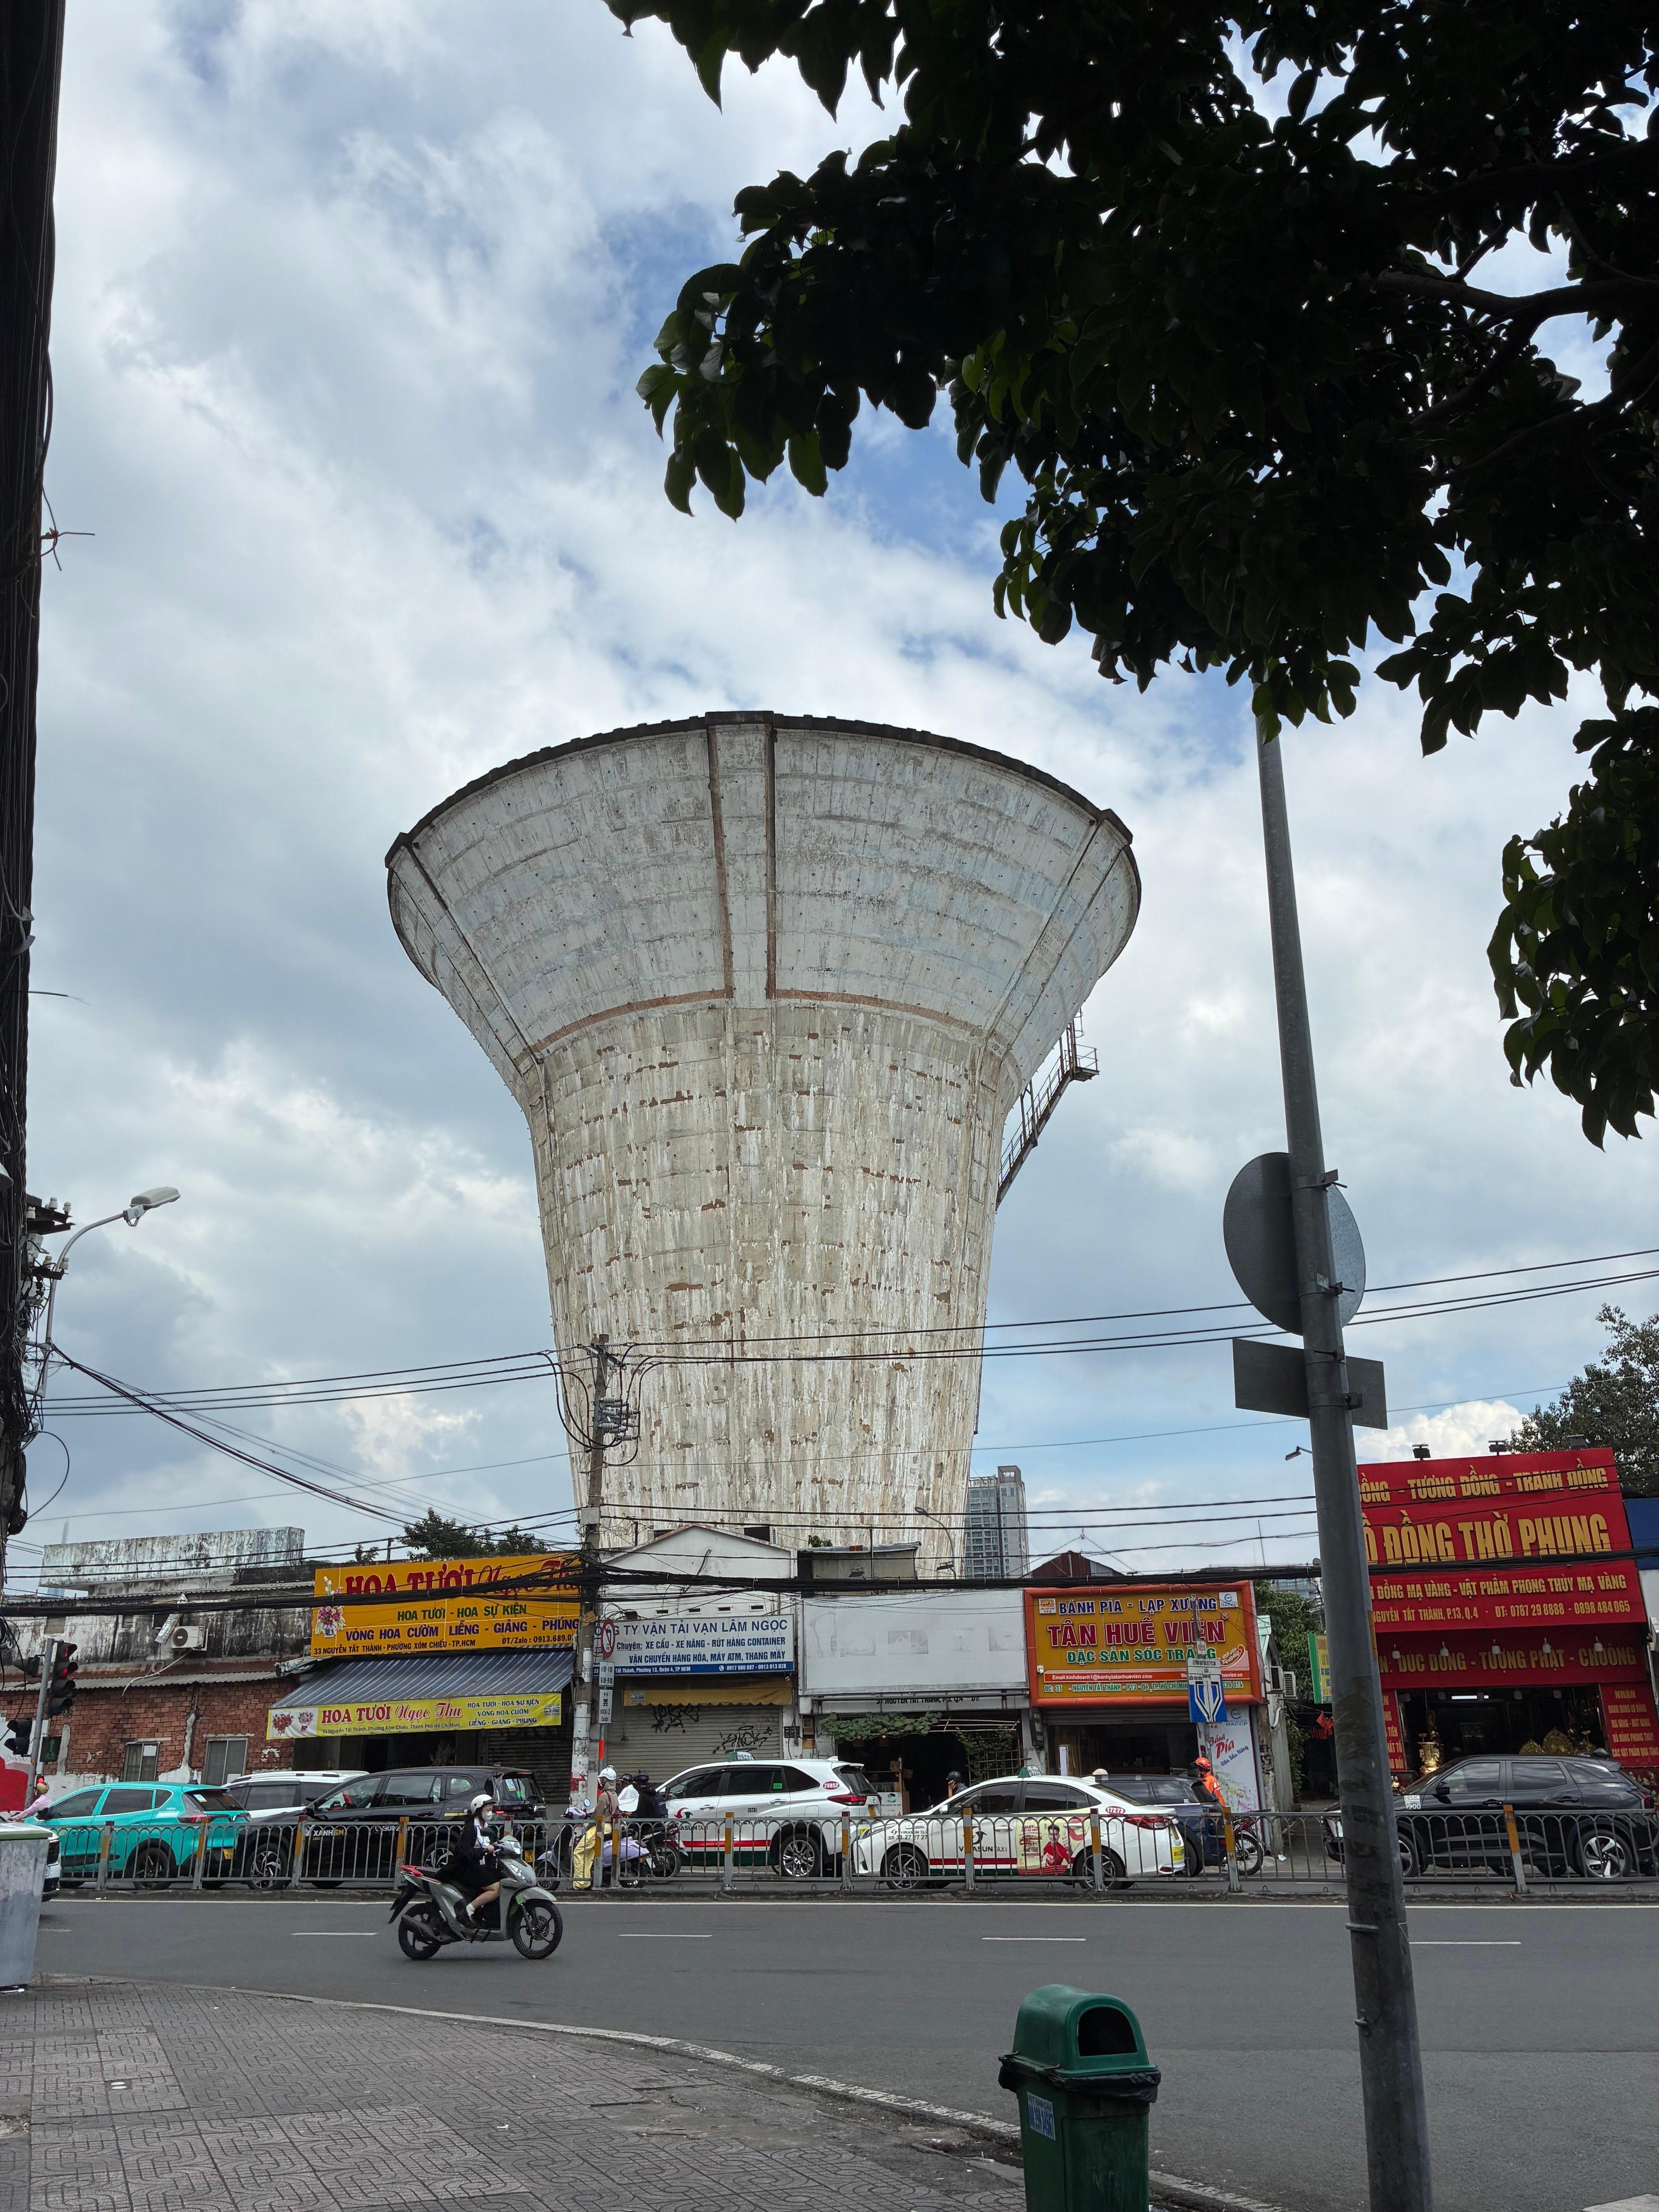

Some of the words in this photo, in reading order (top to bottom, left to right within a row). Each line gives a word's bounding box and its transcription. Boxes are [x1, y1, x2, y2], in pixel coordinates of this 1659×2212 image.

[1360, 1472, 1390, 1503] ỒNG
[1460, 1465, 1501, 1496] ĐỒNG
[1513, 1470, 1564, 1491] TRANH
[1567, 1458, 1609, 1490] ĐỒNG
[1382, 1510, 1456, 1565] ĐỒNG
[1458, 1511, 1513, 1560] THỜ
[345, 1574, 398, 1595] HOA
[1377, 1579, 1404, 1599] ĐỒNG
[1407, 1584, 1423, 1601] MẠ
[1424, 1580, 1451, 1597] VÀNG
[1459, 1578, 1477, 1599] VẬT
[1480, 1573, 1509, 1595] PHẨM
[1512, 1578, 1546, 1594] PHONG
[1547, 1573, 1574, 1592] THỦY
[1577, 1576, 1595, 1594] MẠ
[1597, 1572, 1627, 1590] VÀNG
[397, 1610, 417, 1621] HOA
[421, 1607, 446, 1620] TƯƠI
[457, 1607, 478, 1618] HOA
[484, 1604, 499, 1618] SỰ
[503, 1602, 527, 1618] KIỆN
[1059, 1598, 1095, 1615] BÁNH
[1099, 1598, 1123, 1614] PÍA
[1139, 1599, 1165, 1614] LẠP
[1403, 1606, 1415, 1621] TẤT
[1419, 1607, 1445, 1621] THÀNH,
[1495, 1606, 1507, 1618] ĐT:
[1511, 1605, 1528, 1617] 0787
[1531, 1604, 1542, 1616] 29
[1543, 1603, 1565, 1615] 8888
[1574, 1602, 1596, 1614] 0898
[1597, 1601, 1613, 1613] 484
[1614, 1601, 1630, 1613] 065
[345, 1628, 374, 1641] VÒNG
[379, 1629, 400, 1640] HOA
[407, 1624, 439, 1637] CƯỜM
[448, 1620, 479, 1636] LIỄNG
[493, 1619, 528, 1633] GIẢNG
[542, 1616, 579, 1631] PHÚNG
[624, 1625, 639, 1635] TY
[642, 1622, 666, 1637] VẬN
[670, 1620, 689, 1635] TẢI
[693, 1623, 717, 1635] VẠN
[722, 1619, 747, 1632] LÂM
[752, 1620, 788, 1632] NGỌC
[1047, 1618, 1097, 1647] TÂN
[1105, 1616, 1156, 1645] HUÊ
[323, 1644, 347, 1654] NGUYỄN
[349, 1644, 359, 1653] TẤT
[362, 1643, 382, 1652] THÀNH
[387, 1641, 412, 1651] PHƯỜNG
[414, 1640, 427, 1649] XÓM
[429, 1638, 447, 1648] CHIẾU
[617, 1642, 642, 1650] Chuyên:
[646, 1641, 654, 1649] XE
[657, 1638, 670, 1649] CẨU
[687, 1638, 705, 1648] NÂNG
[712, 1638, 725, 1647] RÚT
[726, 1638, 745, 1647] HÀNG
[747, 1637, 785, 1646] CONTAINER
[629, 1654, 643, 1665] VẬN
[644, 1652, 670, 1663] CHUYỂN
[673, 1653, 690, 1662] HÀNG
[692, 1652, 708, 1663] HÓA,
[710, 1652, 725, 1661] MÁY
[727, 1653, 744, 1661] ATM,
[745, 1652, 768, 1660] THANG
[770, 1650, 785, 1659] MÁY
[1067, 1649, 1096, 1665] ĐẶC
[1099, 1646, 1130, 1662] SẢN
[1133, 1646, 1163, 1661] SÓC
[1165, 1645, 1217, 1661] TRĂG
[1072, 1683, 1093, 1692] NGUYỄN
[1094, 1683, 1104, 1692] TẤT
[1104, 1683, 1122, 1692] THÀNH
[321, 1708, 353, 1725] HOA
[356, 1704, 392, 1722] TƯƠI
[394, 1704, 430, 1723] Ngọc
[434, 1702, 463, 1719] Thu
[1216, 1738, 1235, 1759] Pía
